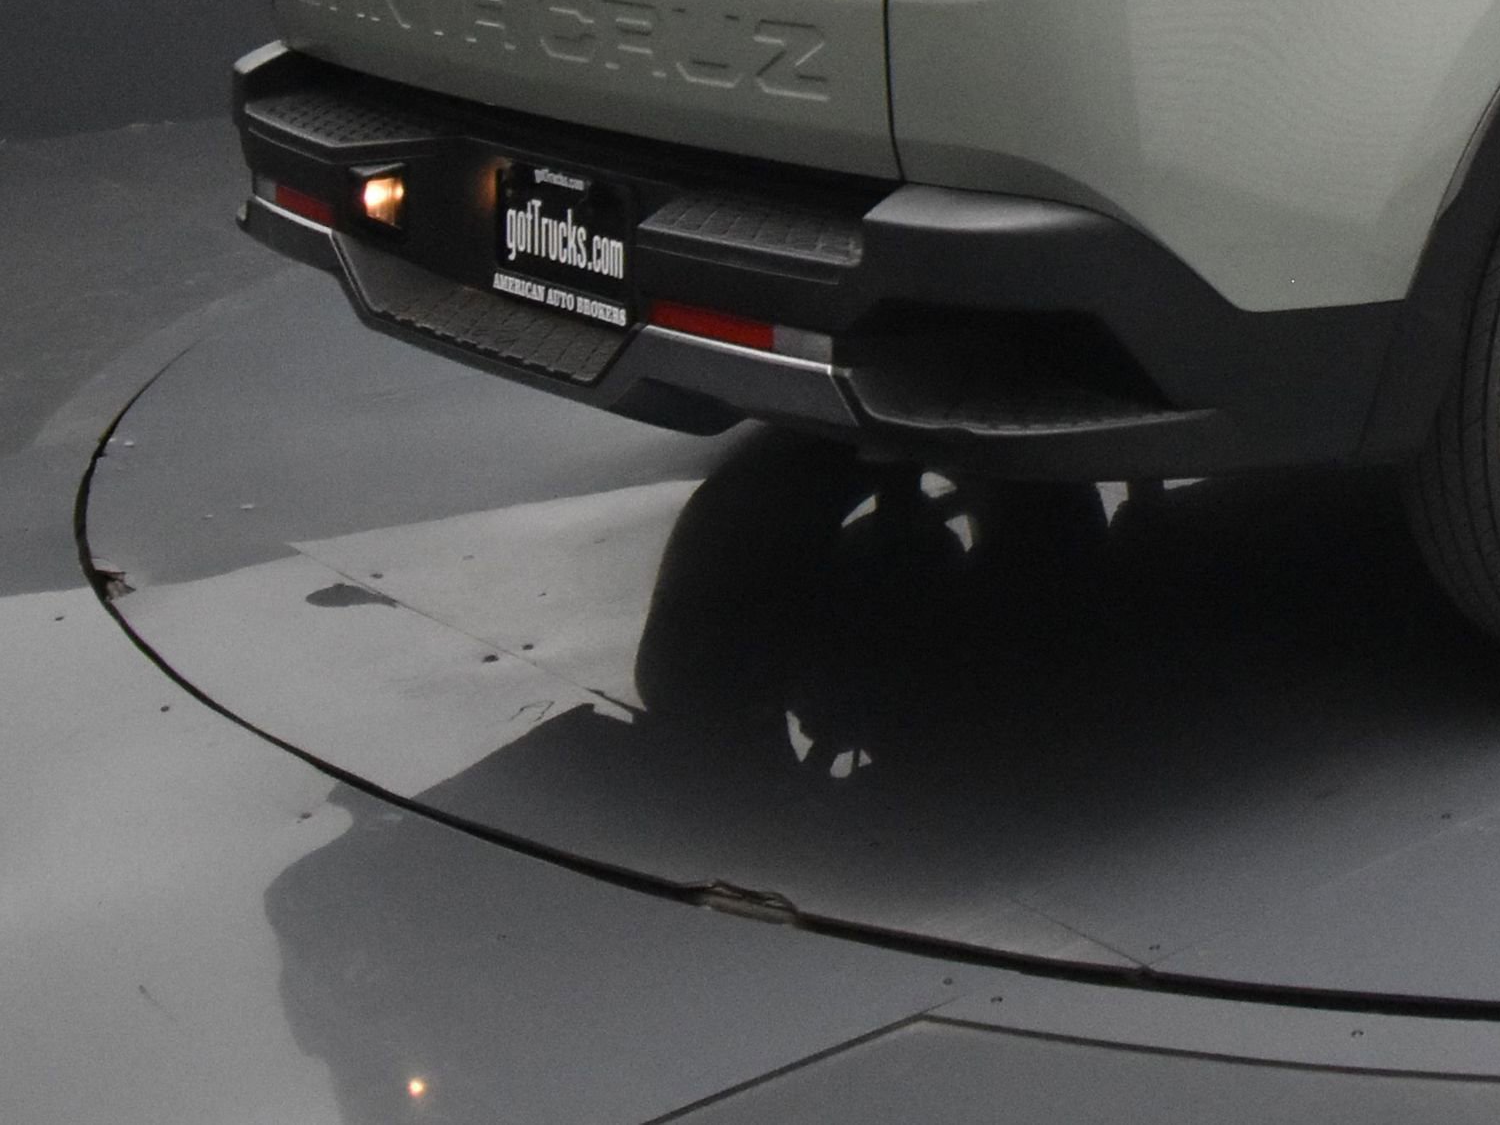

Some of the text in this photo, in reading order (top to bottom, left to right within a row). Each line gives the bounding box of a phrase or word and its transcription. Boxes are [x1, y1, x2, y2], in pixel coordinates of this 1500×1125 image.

[506, 198, 624, 279] gotTrucks.com
[493, 272, 627, 327] AMERICAN AUTO BROKERS
